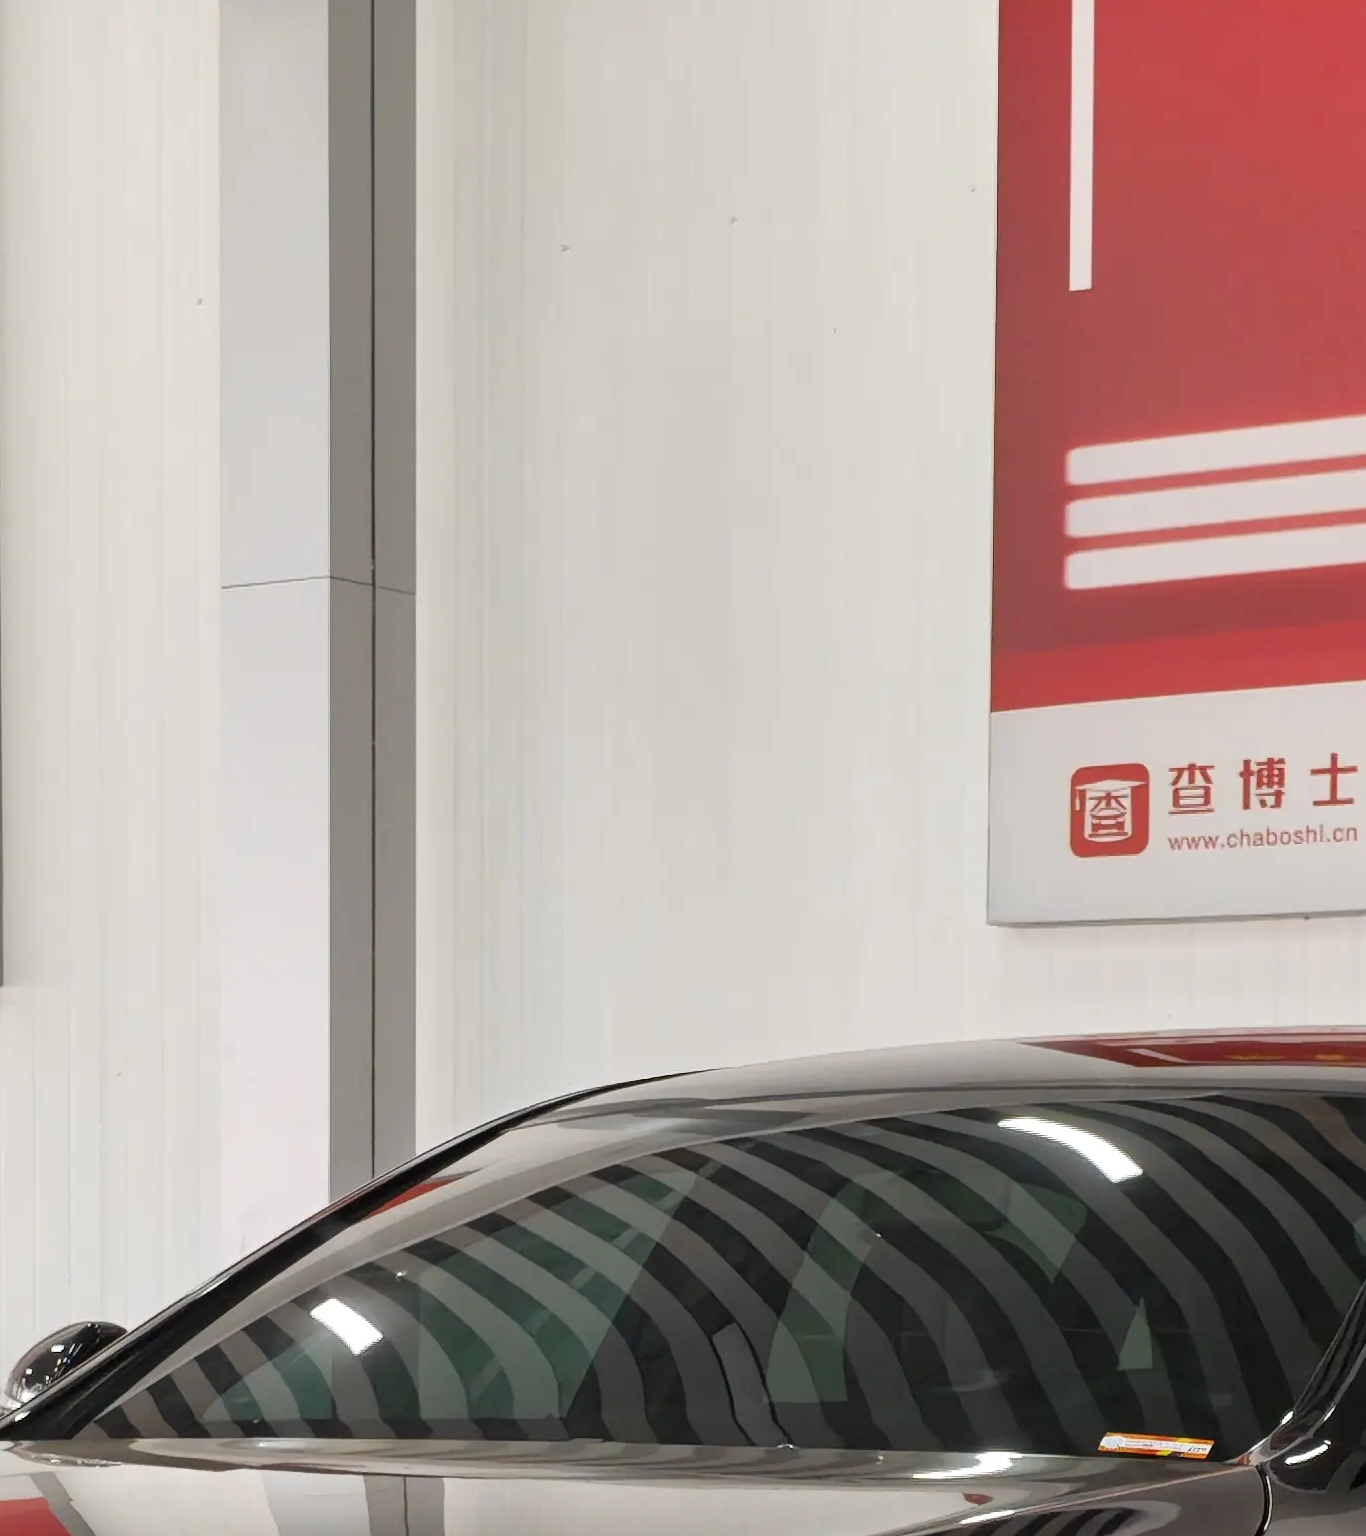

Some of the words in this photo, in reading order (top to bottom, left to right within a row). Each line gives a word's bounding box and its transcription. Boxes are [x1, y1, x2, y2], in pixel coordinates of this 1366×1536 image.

[1168, 752, 1358, 815] 查博士
[1168, 823, 1359, 852] www.chaboshi.cn
